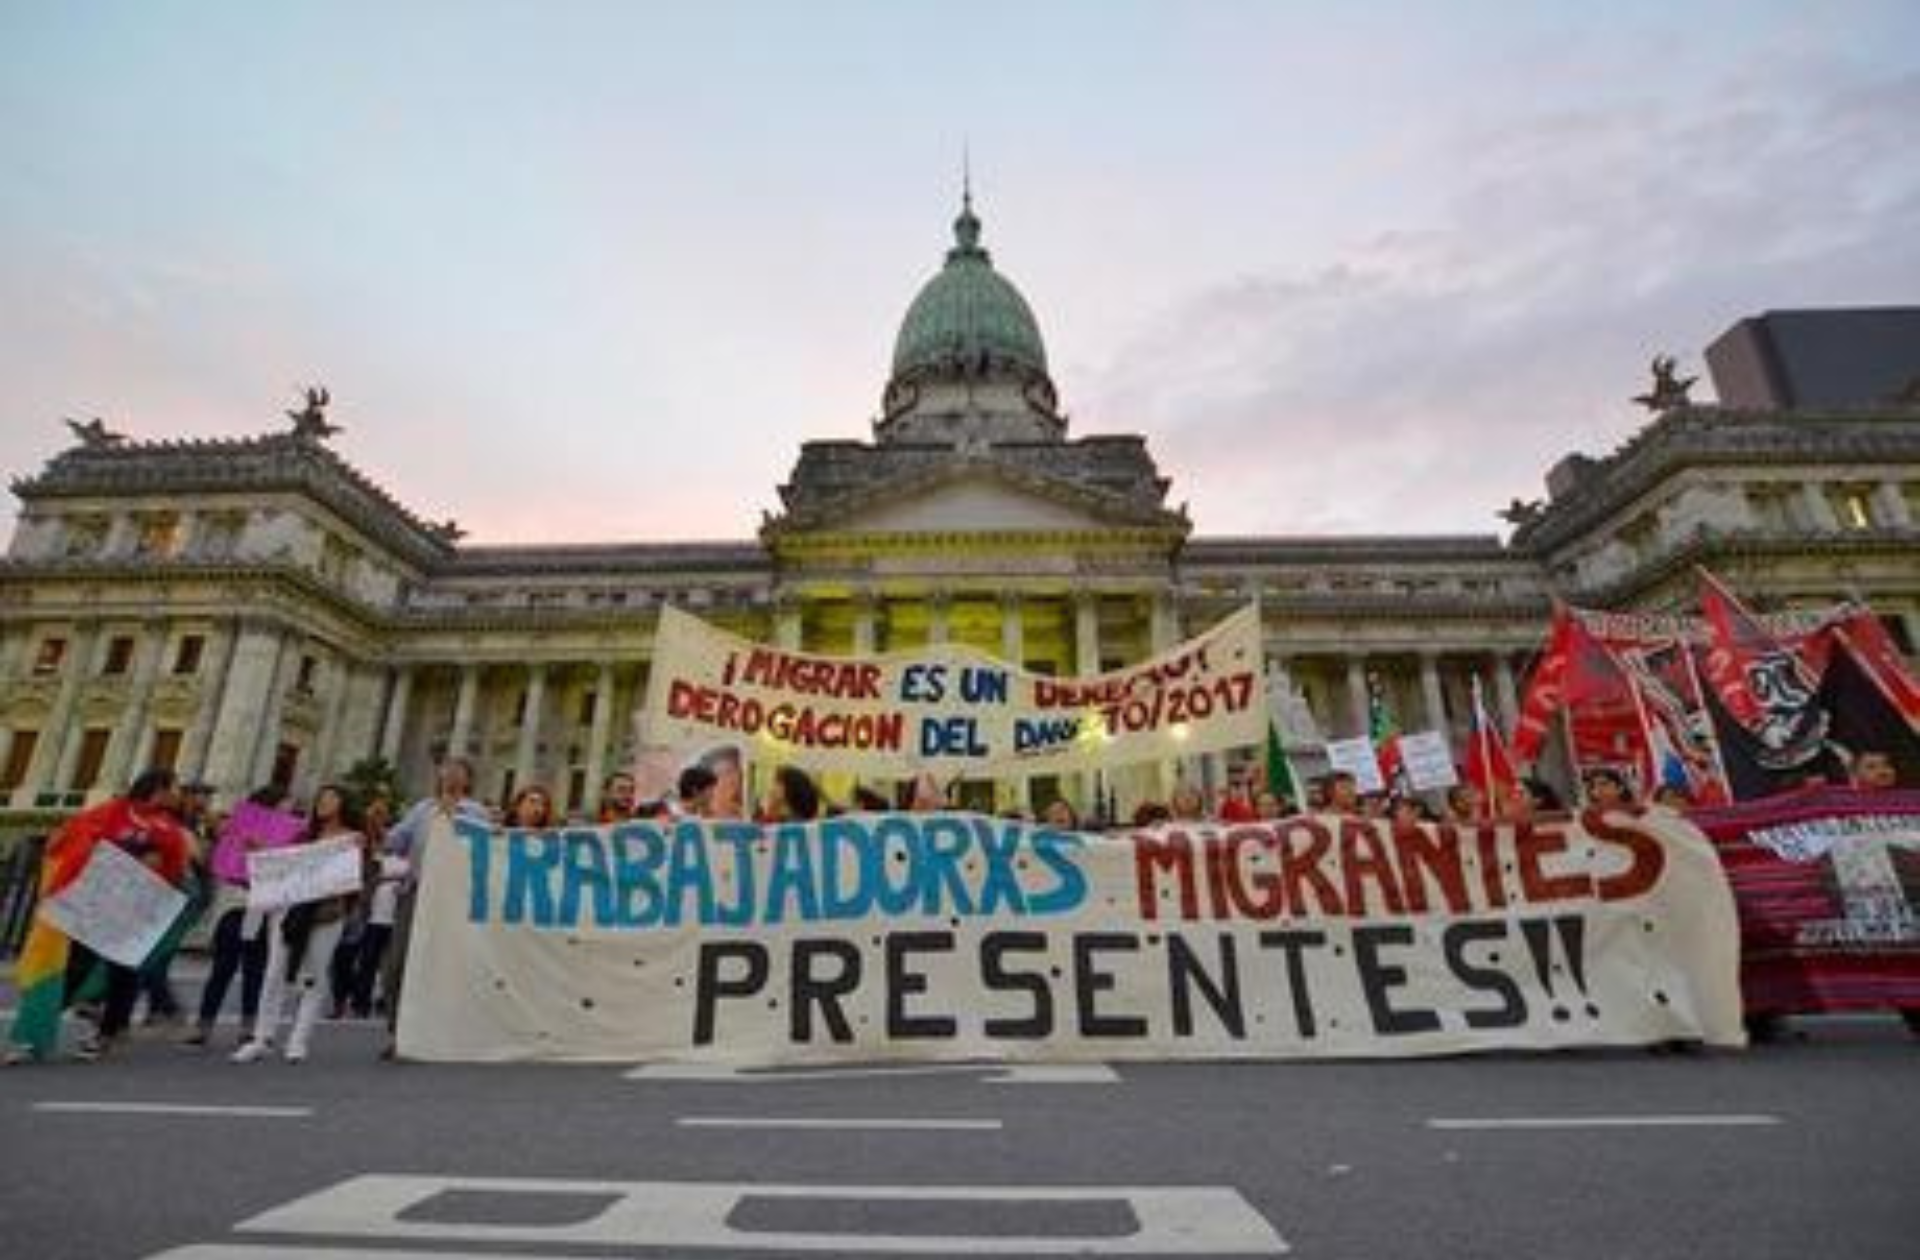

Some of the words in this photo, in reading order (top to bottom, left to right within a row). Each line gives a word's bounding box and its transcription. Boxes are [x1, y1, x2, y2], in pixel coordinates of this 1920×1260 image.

[668, 679, 903, 752] DEROGACION
[922, 718, 988, 756] DEL
[902, 665, 947, 702] ES
[961, 667, 1006, 704] UN
[454, 815, 1088, 927] TRABAJADORXS
[1133, 804, 1666, 921] MIGRANTES
[693, 914, 1600, 1045] PRESENTES!!
